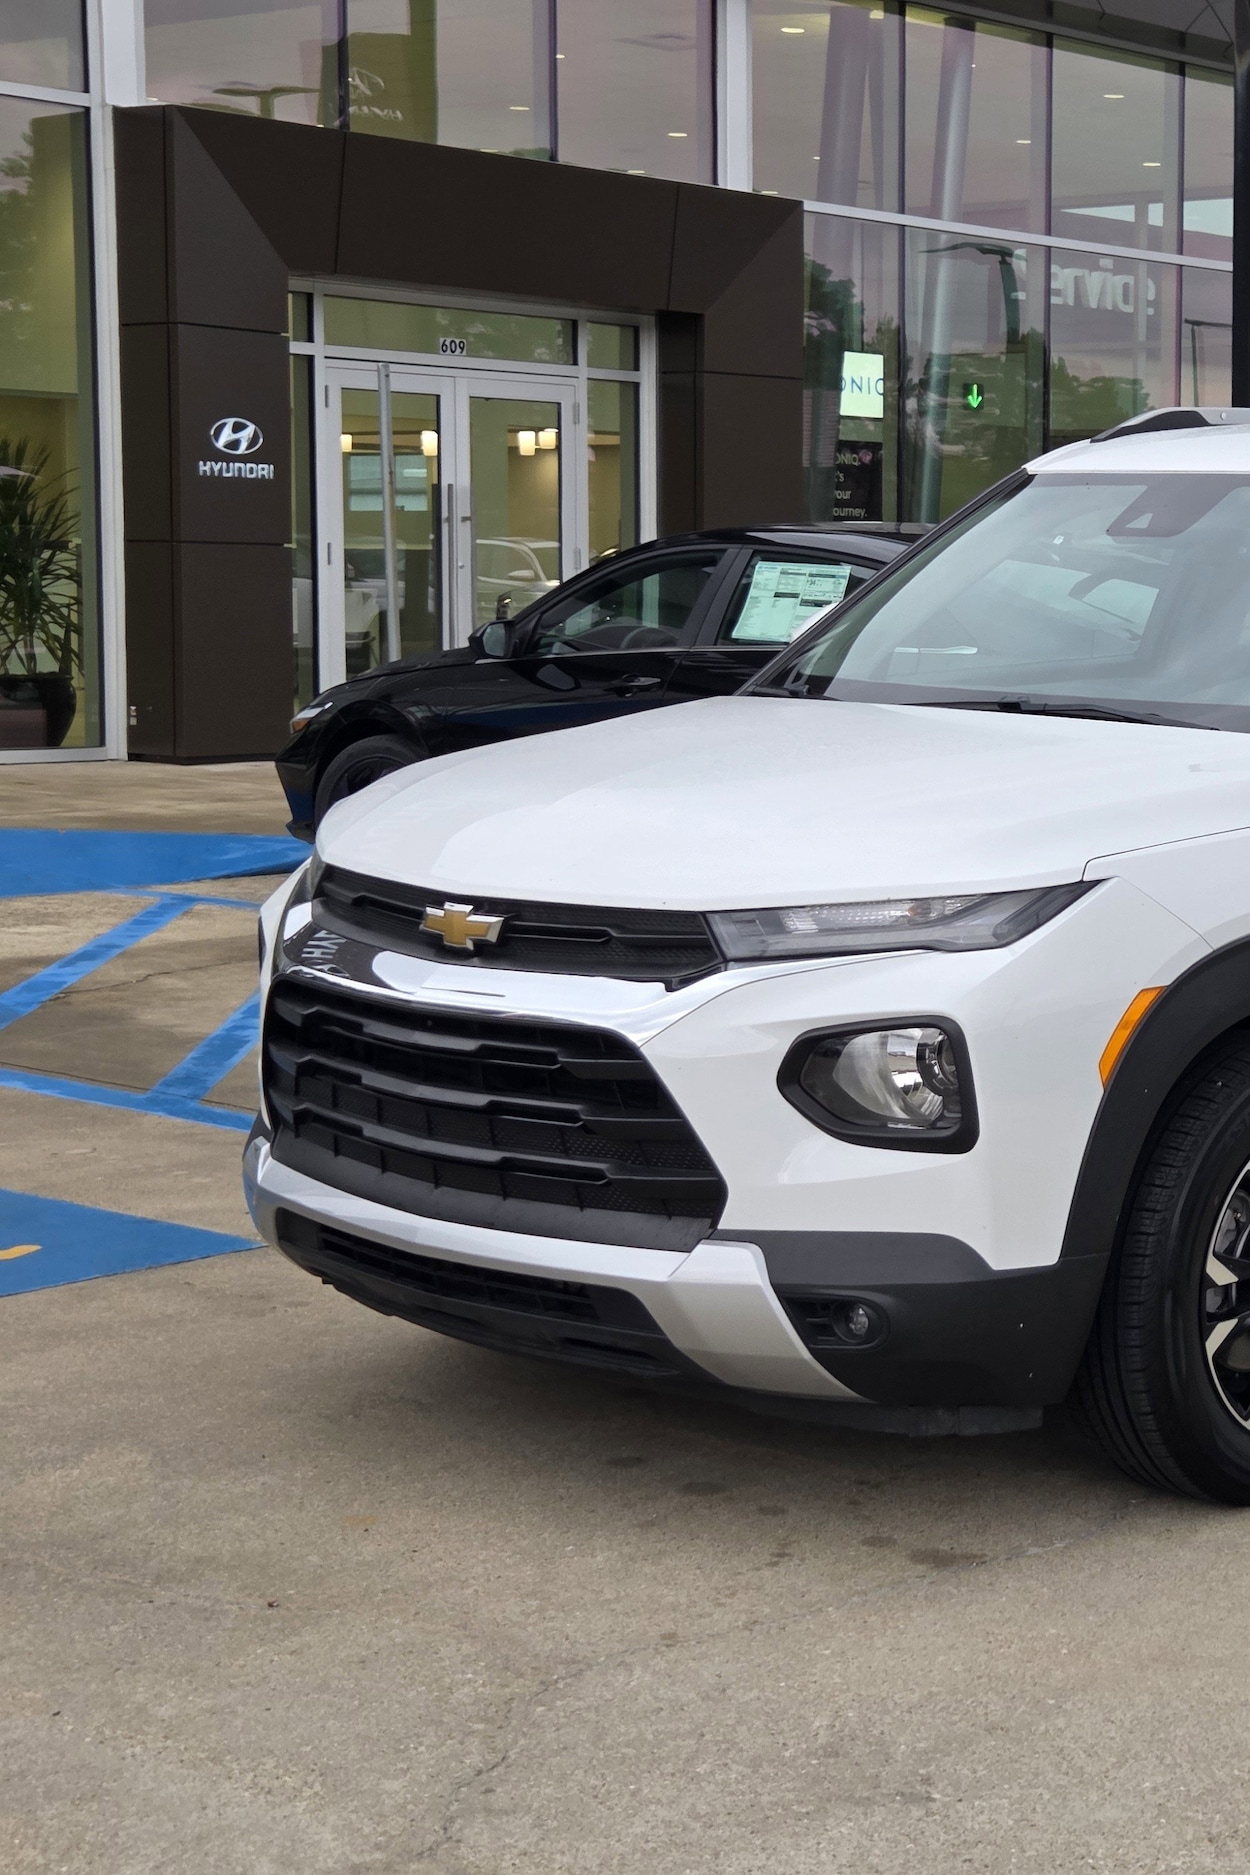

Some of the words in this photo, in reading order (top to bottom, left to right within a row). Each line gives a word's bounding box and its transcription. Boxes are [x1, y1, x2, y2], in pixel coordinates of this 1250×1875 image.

[441, 339, 465, 354] 609
[199, 460, 274, 479] HYUNDAI
[834, 490, 852, 500] our
[832, 507, 868, 519] ourney.
